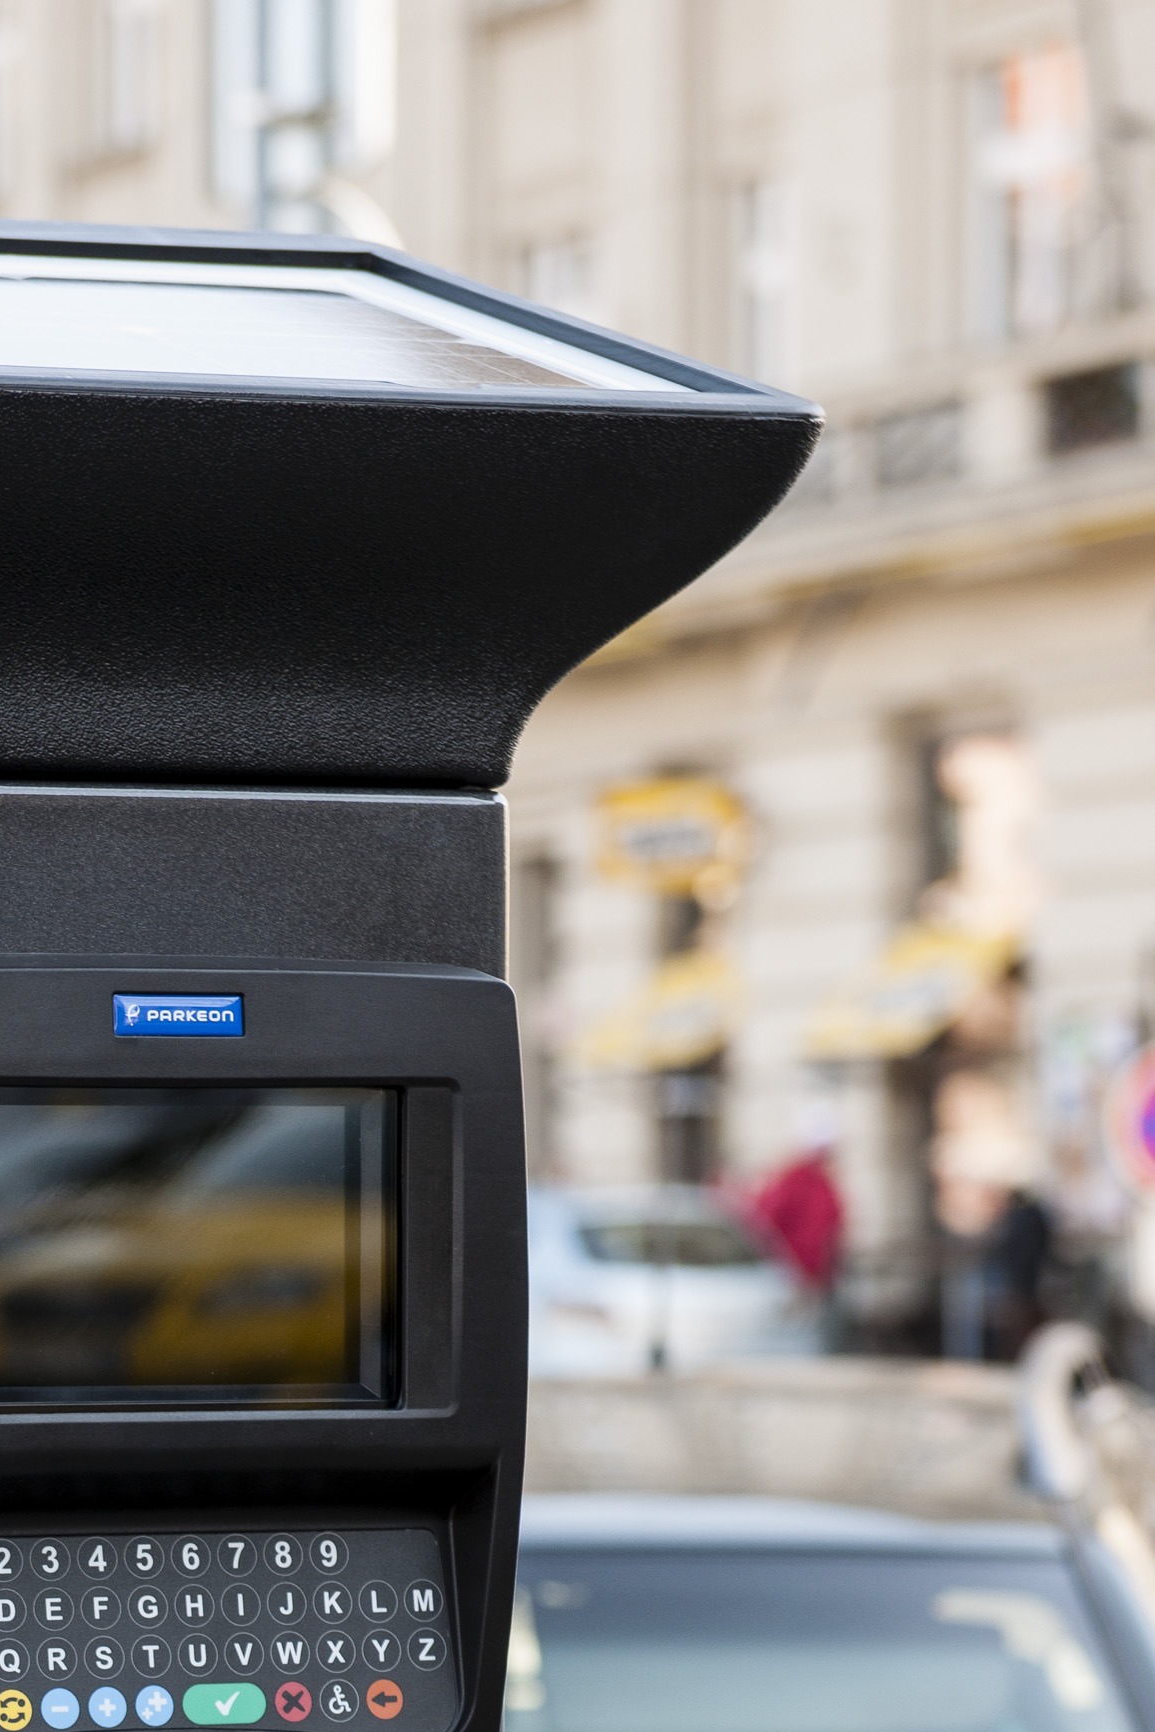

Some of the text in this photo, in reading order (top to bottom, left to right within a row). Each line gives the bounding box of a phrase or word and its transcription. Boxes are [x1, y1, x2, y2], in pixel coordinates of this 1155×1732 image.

[147, 1009, 235, 1022] PARKEON
[41, 1545, 60, 1574] 3
[88, 1544, 107, 1572] 4
[136, 1543, 154, 1571] 5
[182, 1542, 200, 1571] 6
[228, 1542, 245, 1569] 7
[274, 1540, 292, 1569] 8
[319, 1540, 338, 1568] 9
[45, 1597, 64, 1621] E
[93, 1596, 109, 1620] F
[137, 1595, 159, 1619] G
[185, 1594, 204, 1618] H
[237, 1593, 245, 1616] I
[279, 1591, 294, 1615] J
[323, 1591, 344, 1614] K
[370, 1590, 388, 1613] L
[412, 1589, 434, 1612] M
[47, 1647, 68, 1671] R
[95, 1646, 114, 1670] S
[141, 1644, 160, 1668] T
[188, 1643, 207, 1668] U
[233, 1642, 253, 1666] V
[276, 1641, 303, 1665] W
[326, 1640, 346, 1664] X
[371, 1639, 390, 1663] Y
[418, 1638, 436, 1661] Z
